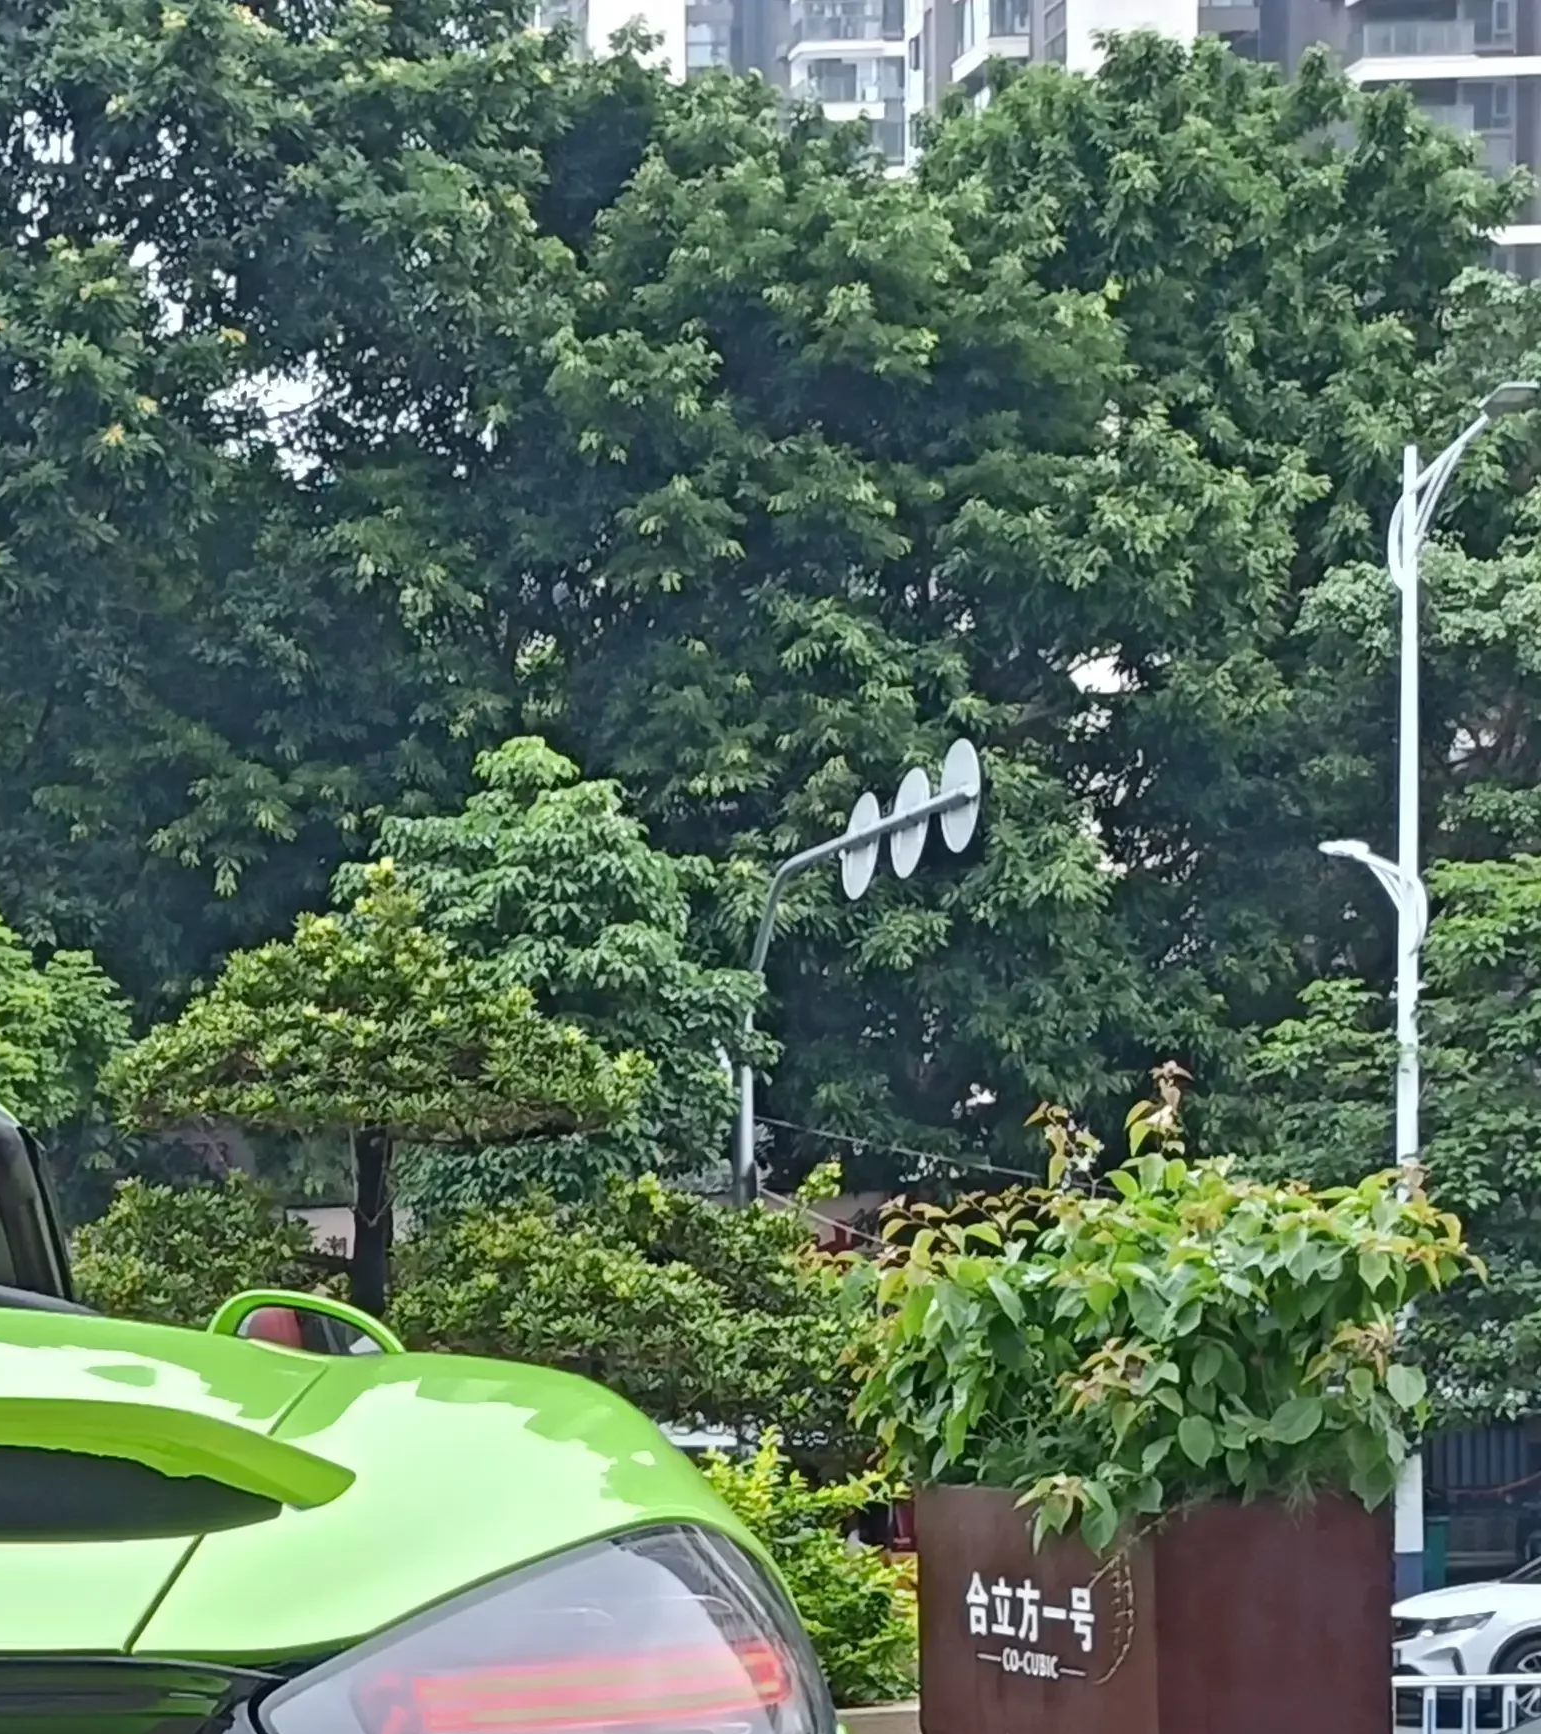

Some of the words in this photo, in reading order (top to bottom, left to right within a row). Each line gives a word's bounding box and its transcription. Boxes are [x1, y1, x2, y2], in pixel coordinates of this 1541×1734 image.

[965, 1570, 1096, 1653] 合立方一号
[1002, 1646, 1060, 1681] CO-CUBIC
